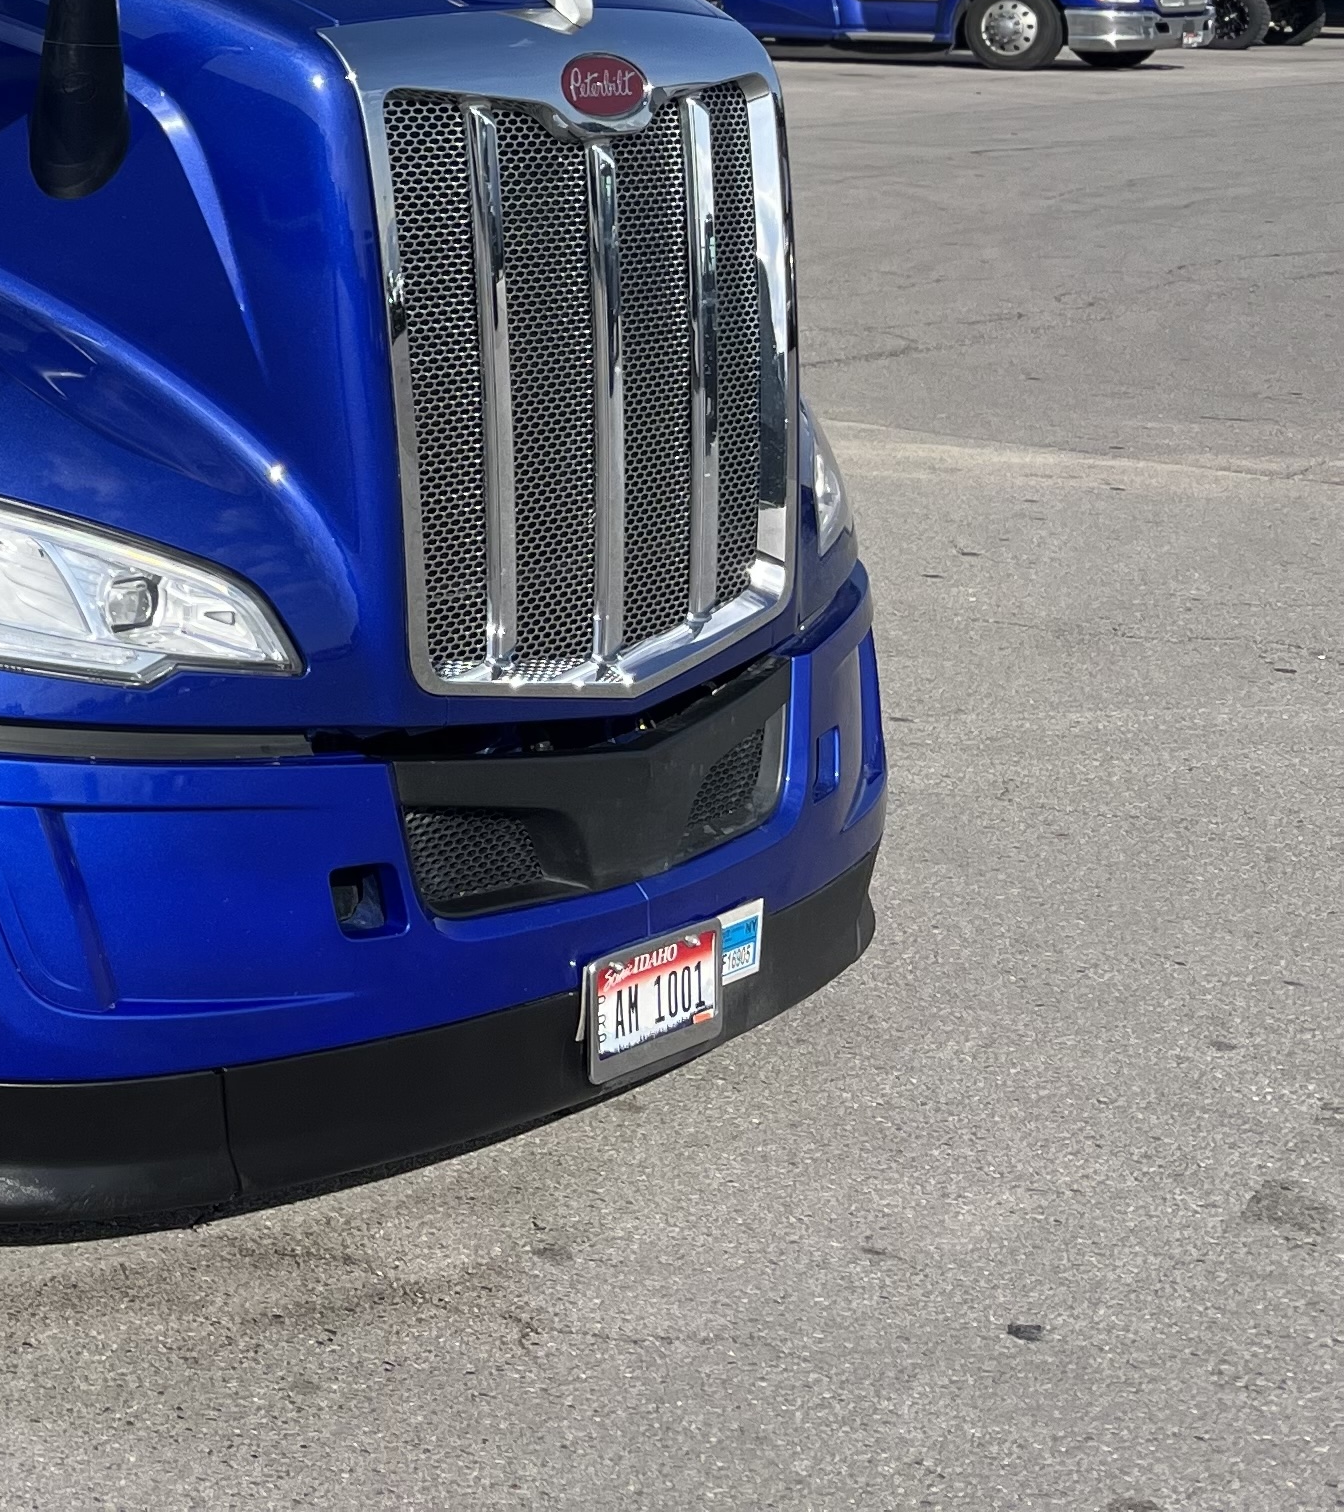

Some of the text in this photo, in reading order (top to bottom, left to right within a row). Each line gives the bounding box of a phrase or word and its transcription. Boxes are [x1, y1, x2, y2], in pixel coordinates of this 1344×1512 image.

[569, 67, 635, 102] Peterbilt
[745, 918, 757, 934] NY
[632, 943, 678, 975] IDAHO
[615, 960, 706, 1039] AM 1001
